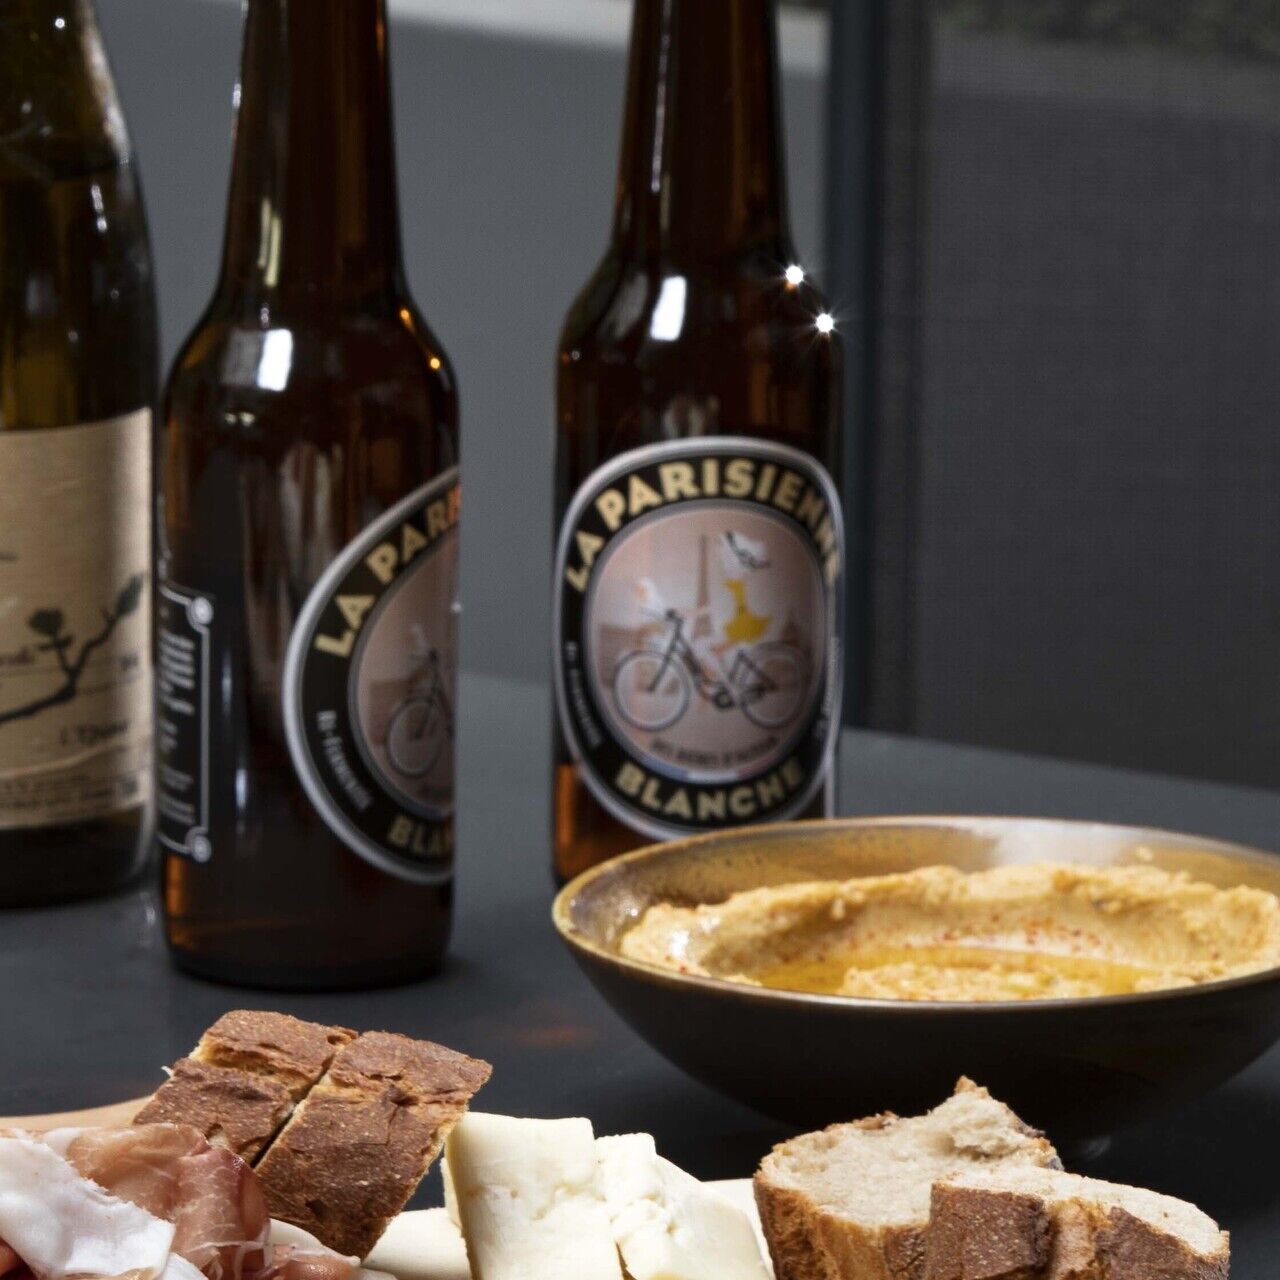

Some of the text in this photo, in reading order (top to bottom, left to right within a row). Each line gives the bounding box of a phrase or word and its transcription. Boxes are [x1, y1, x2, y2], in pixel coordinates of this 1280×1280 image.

[566, 531, 604, 593] LA
[314, 594, 376, 658] LA
[615, 761, 802, 820] BLANCHE
